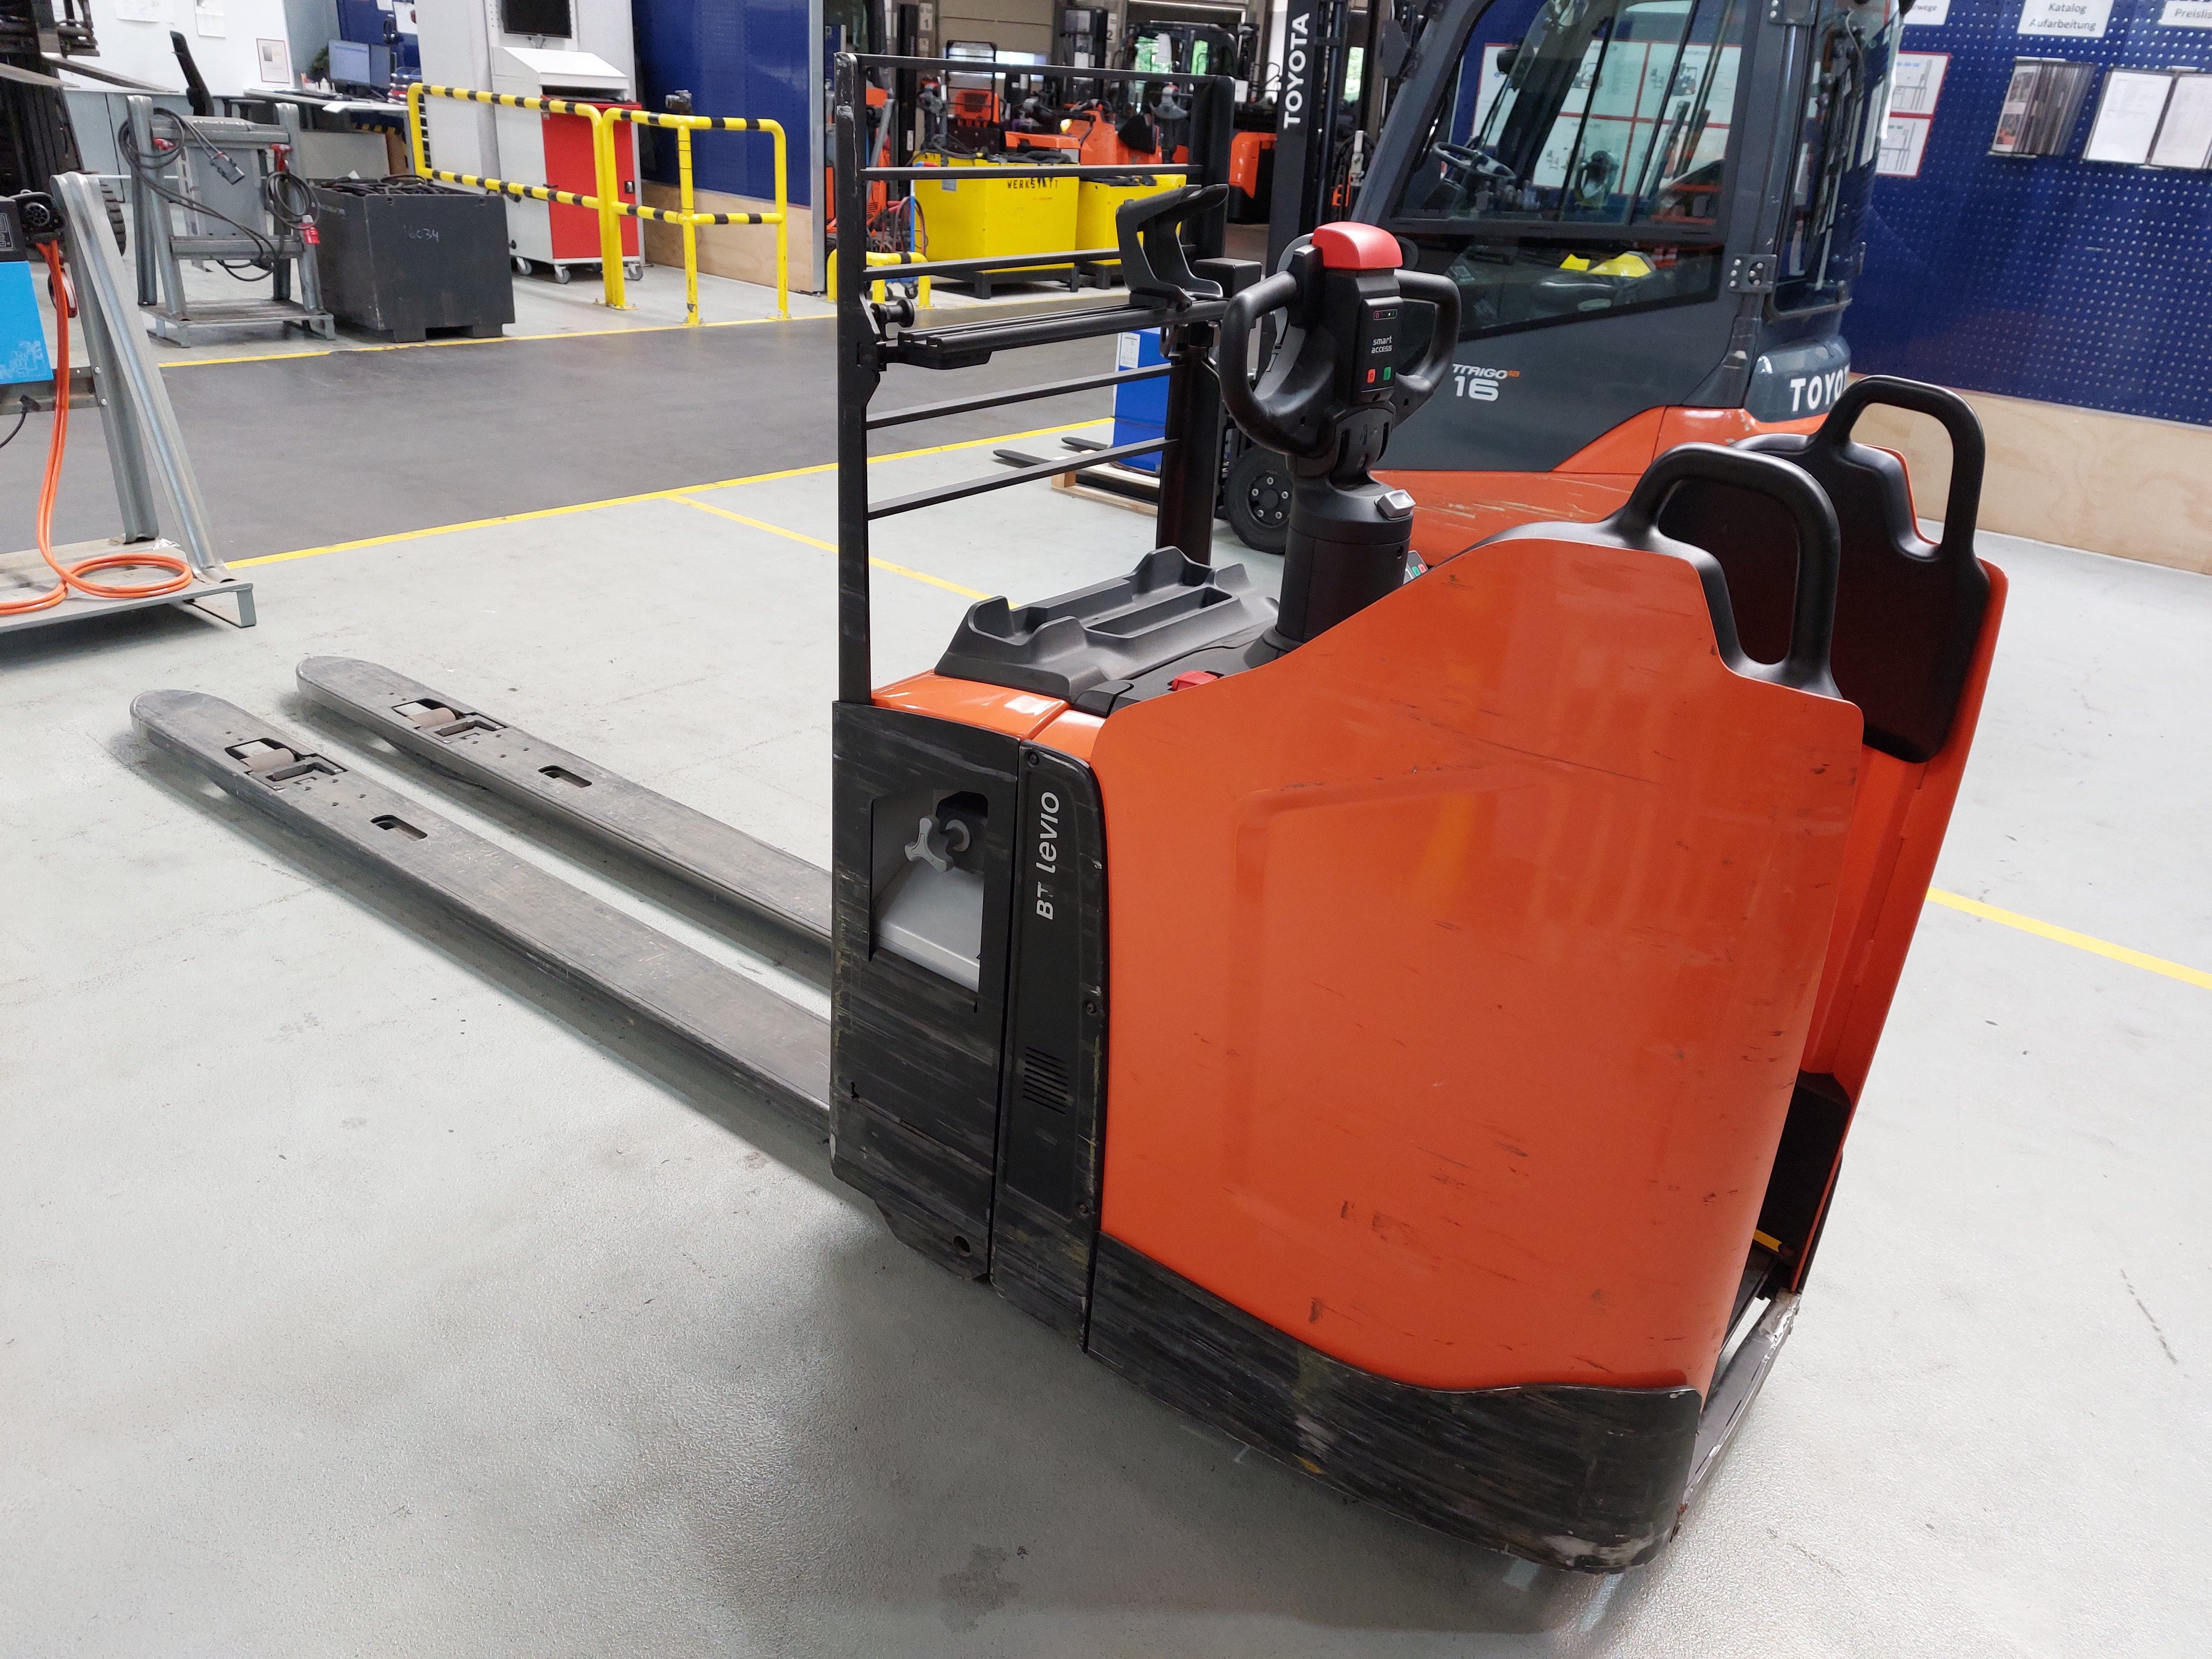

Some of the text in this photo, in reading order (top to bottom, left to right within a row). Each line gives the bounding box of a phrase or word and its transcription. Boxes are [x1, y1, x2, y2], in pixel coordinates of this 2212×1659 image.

[2048, 3, 2087, 15] Katalog
[2029, 18, 2097, 31] Aufarbeitung
[1283, 12, 1310, 129] TOYOTA
[1007, 179, 1058, 188] WERKSTATT
[1372, 335, 1393, 346] smart
[1371, 344, 1393, 354] access
[1454, 376, 1499, 401] 16
[1036, 881, 1054, 920] BT
